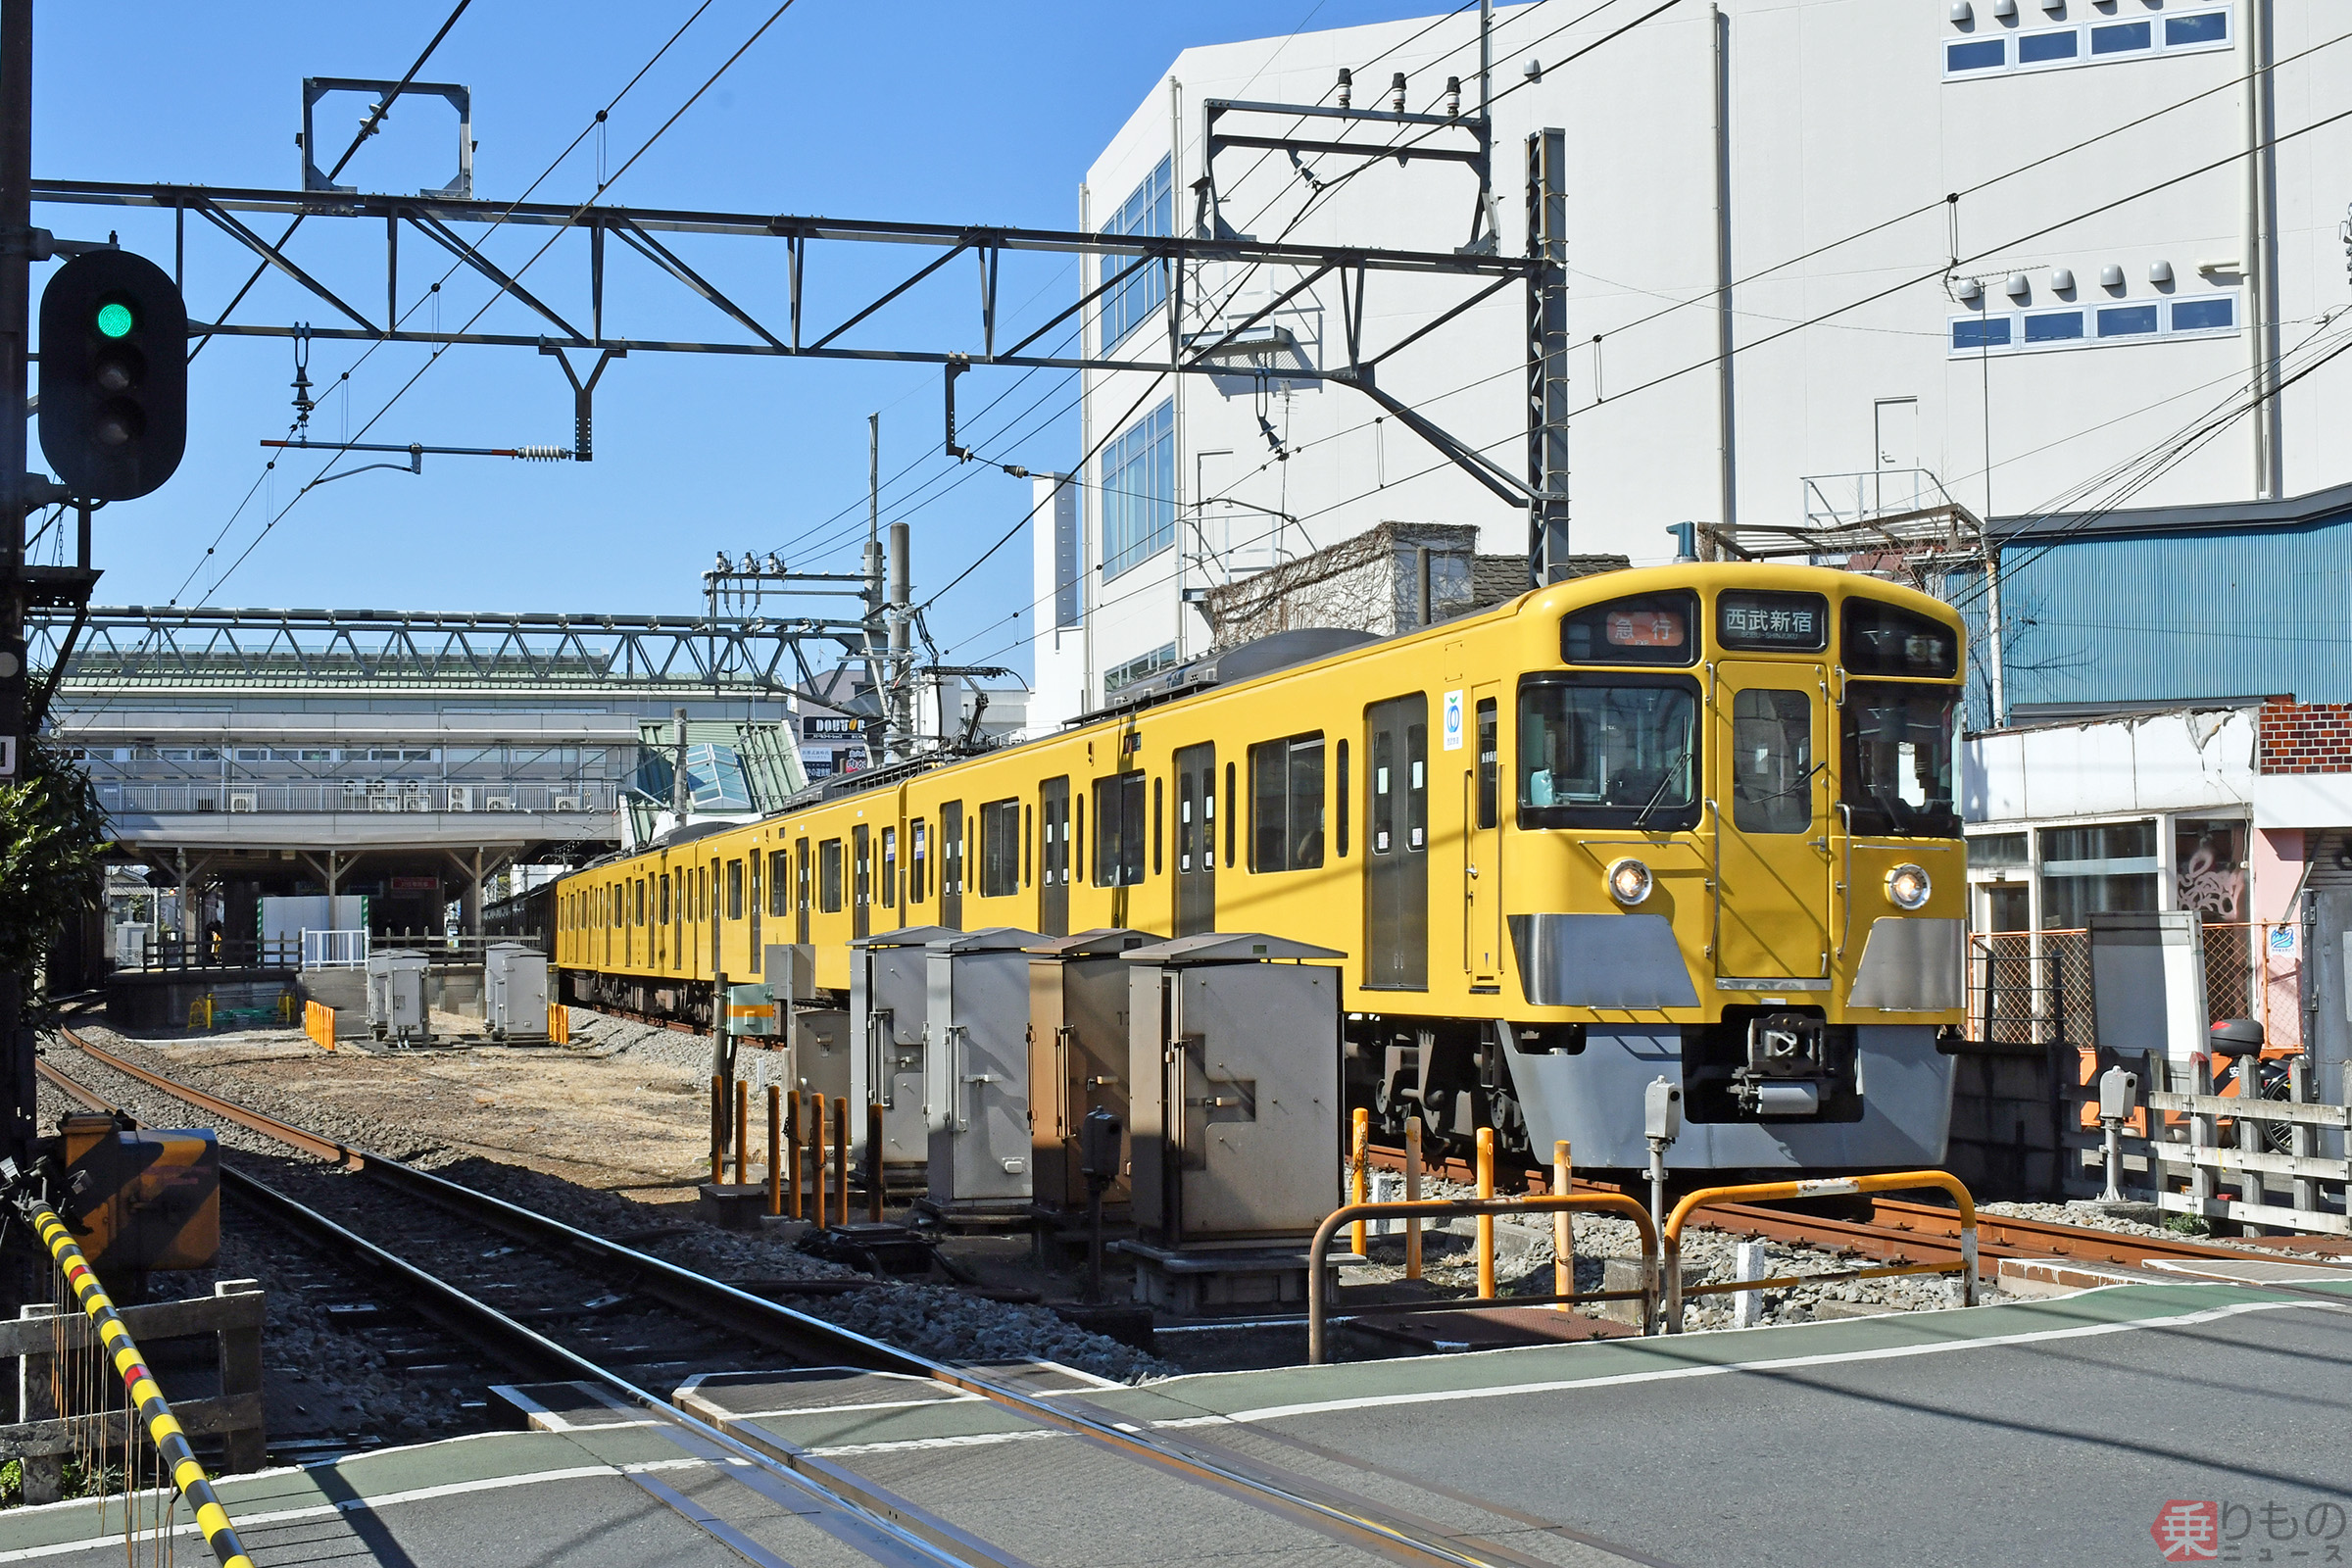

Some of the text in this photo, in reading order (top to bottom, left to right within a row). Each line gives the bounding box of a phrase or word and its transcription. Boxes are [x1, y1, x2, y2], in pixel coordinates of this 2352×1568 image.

[1615, 618, 1673, 640] 急行
[1726, 609, 1813, 633] 西武新宿
[815, 718, 865, 732] DOUTOR
